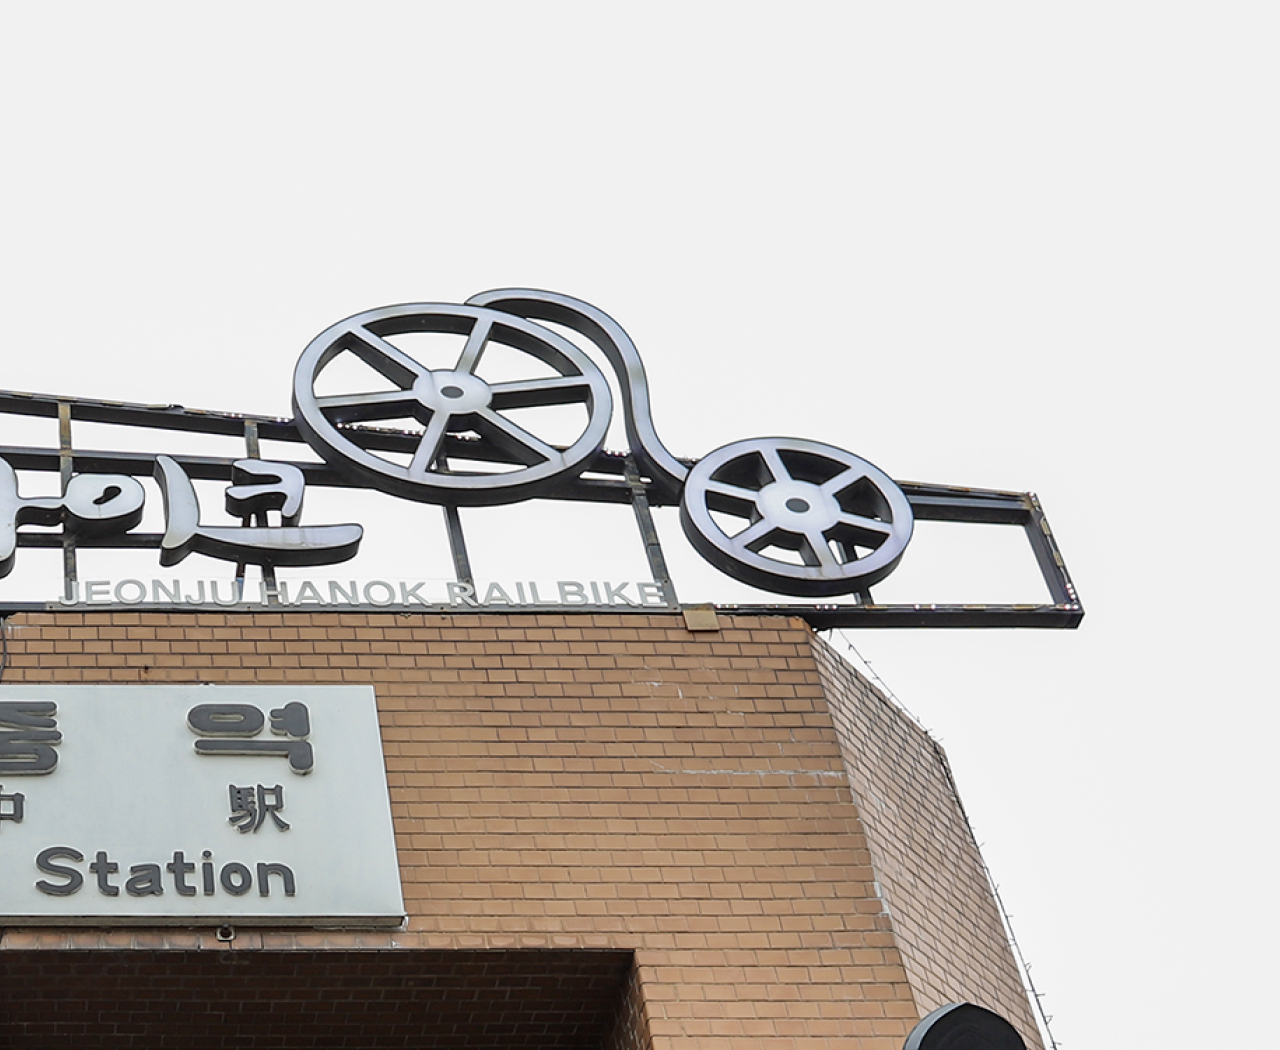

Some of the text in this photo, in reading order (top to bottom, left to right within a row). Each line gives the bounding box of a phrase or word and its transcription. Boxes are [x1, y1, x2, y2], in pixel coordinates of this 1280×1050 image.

[58, 579, 669, 608] JEONJU HANOK RAILBIKE
[35, 845, 296, 897] Station
